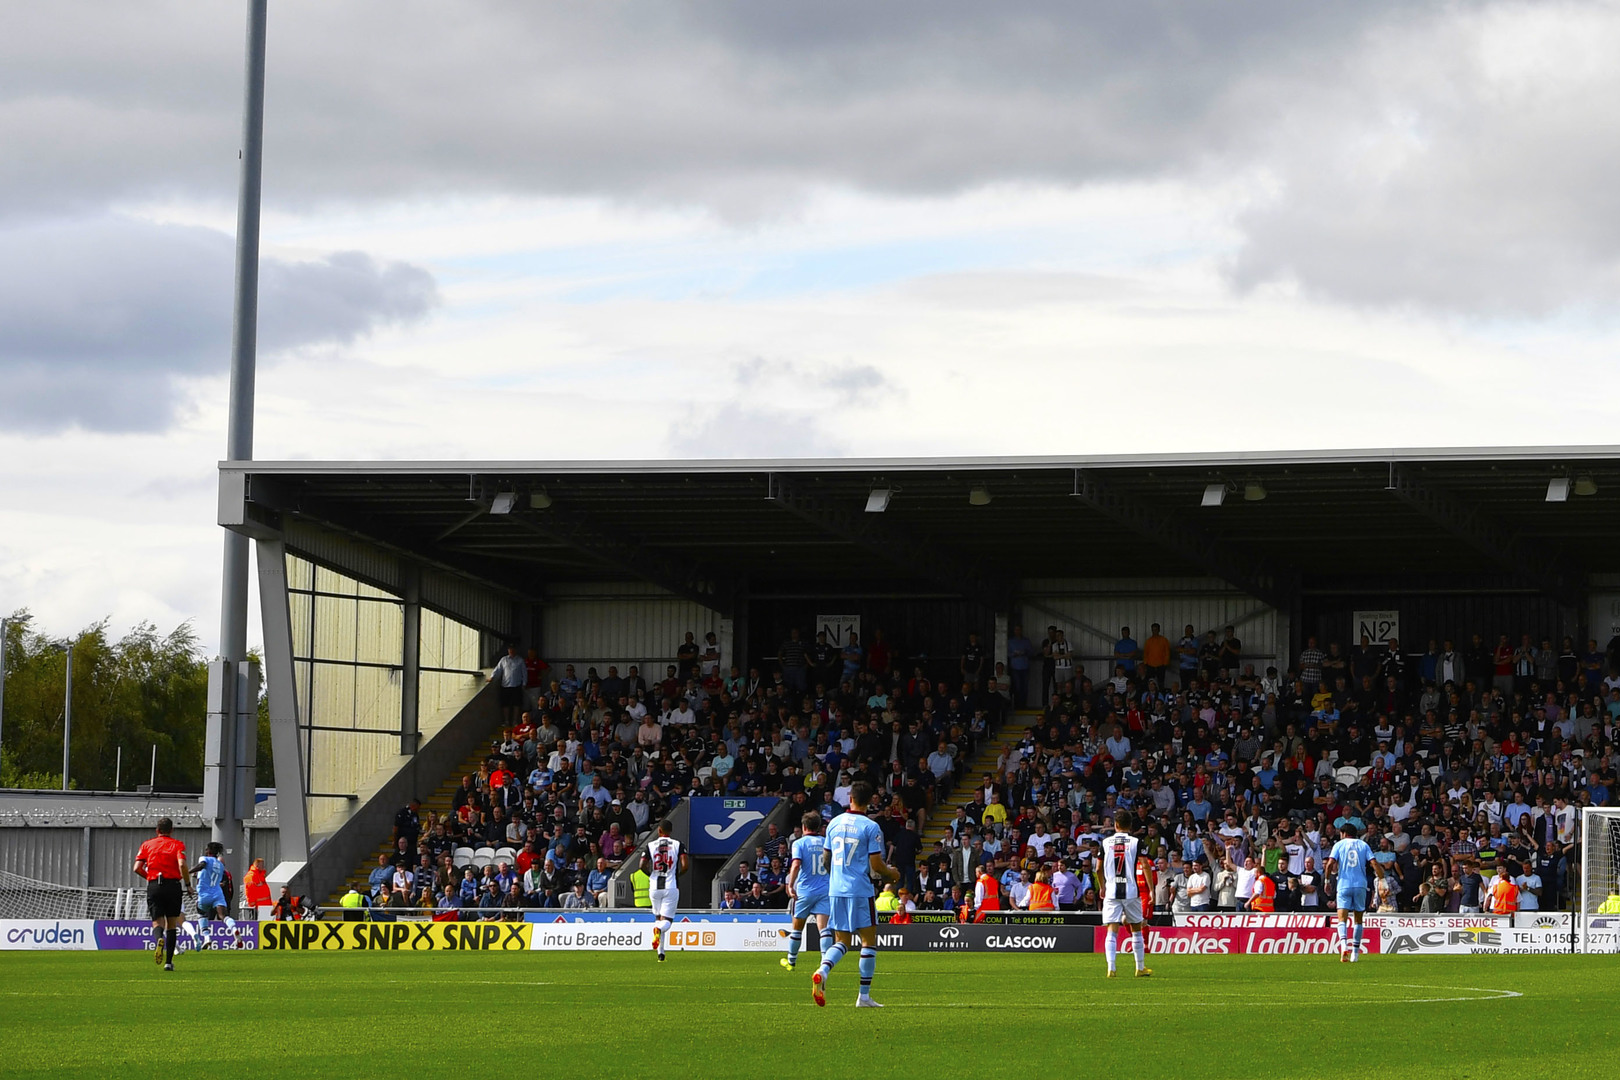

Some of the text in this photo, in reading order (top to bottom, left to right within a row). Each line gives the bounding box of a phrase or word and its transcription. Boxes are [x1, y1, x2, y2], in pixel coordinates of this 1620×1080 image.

[1360, 620, 1392, 642] N2
[831, 835, 860, 867] 27
[1347, 849, 1358, 868] 9
[653, 853, 673, 871] 24
[810, 853, 828, 876] 18
[1114, 852, 1125, 875] 7
[1022, 916, 1038, 924] 0141
[1039, 916, 1051, 924] 237
[1362, 917, 1499, 929] HIRE SALES SERVICE
[7, 921, 84, 944] cruden
[262, 923, 500, 950] SNP SNP SNP
[543, 931, 643, 946] intu Braehead
[758, 928, 777, 938] intu
[850, 934, 903, 947] INNITI
[1512, 933, 1541, 944] TEL:
[1544, 933, 1580, 944] 01505
[743, 939, 777, 947] Braehead
[985, 935, 1057, 949] GLASGOW
[1386, 931, 1502, 954] ACRE
